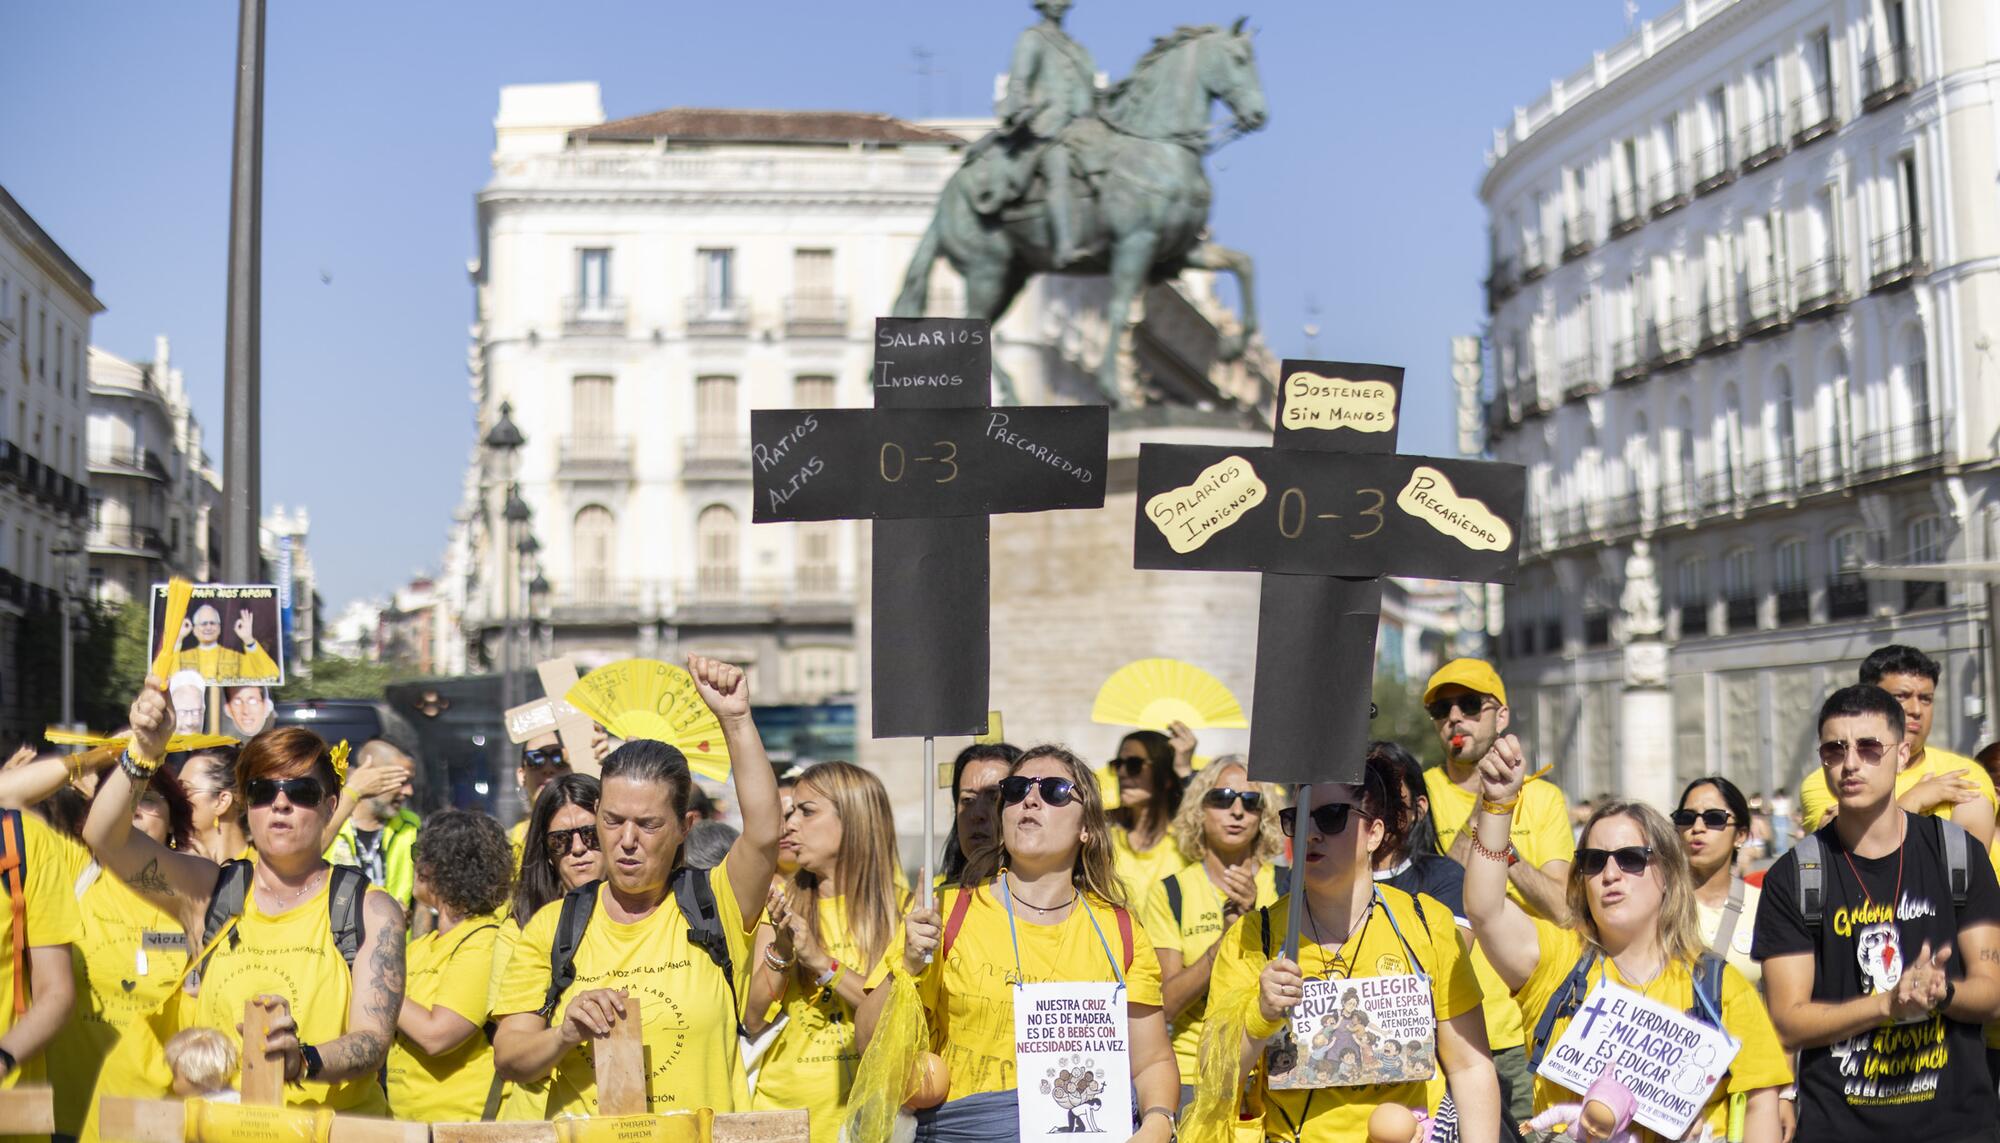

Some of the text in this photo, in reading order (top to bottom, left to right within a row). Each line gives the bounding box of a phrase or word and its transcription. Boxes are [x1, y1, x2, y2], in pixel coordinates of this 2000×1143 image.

[879, 328, 984, 348] SALARIOS
[876, 361, 963, 387] INDIGNOS
[1293, 377, 1385, 399] SOSTENER
[1330, 408, 1386, 421] MANOS
[753, 414, 818, 472] RATIOS
[986, 412, 1093, 483] PRECARIEDAD
[879, 441, 959, 483] 0-3
[768, 455, 824, 514] ALTAS
[1154, 465, 1241, 526] SALARIOS
[1178, 485, 1257, 543] INDIGNOS
[1278, 487, 1385, 539] 0-3
[1408, 476, 1497, 544] PRECARIEDAD
[1200, 912, 1218, 921] POR
[1195, 924, 1221, 935] ETAPA
[248, 946, 265, 956] VOZ
[576, 974, 601, 983] OMOS
[613, 969, 630, 978] VOZ
[631, 966, 642, 974] DE
[644, 966, 655, 974] LA
[1304, 982, 1338, 998] ESTRA
[1362, 978, 1419, 998] ELEGIR
[644, 986, 685, 1026] LABORAL
[1036, 999, 1106, 1011] NUESTRA CRUZ
[1292, 996, 1338, 1019] CRUZ
[1364, 994, 1430, 1011] QUIÉN ESPERA
[1027, 1013, 1114, 1025] NO ES DE MADERA,
[1377, 1008, 1419, 1019] MIENTRAS
[1381, 1016, 1430, 1029] ATENDEMOS
[1610, 998, 1700, 1049] EL VERDADERO
[1027, 1024, 1116, 1039] ES DE 8 BEBÉS CON
[1297, 1021, 1311, 1034] ES
[1394, 1027, 1427, 1038] A OTRO
[1017, 1040, 1126, 1053] NECESIDADES A LA VEZ.
[1608, 1021, 1683, 1066] MILAGRO
[645, 1033, 685, 1081] FANTILES
[1595, 1039, 1671, 1085] ES EDUCAR
[1548, 1060, 1582, 1080] RATIOS ALTAS
[1556, 1044, 1696, 1118] CON ESTS CONDICIONES
[1844, 1074, 1938, 1097] 0-3 ES EDUCACIÓN
